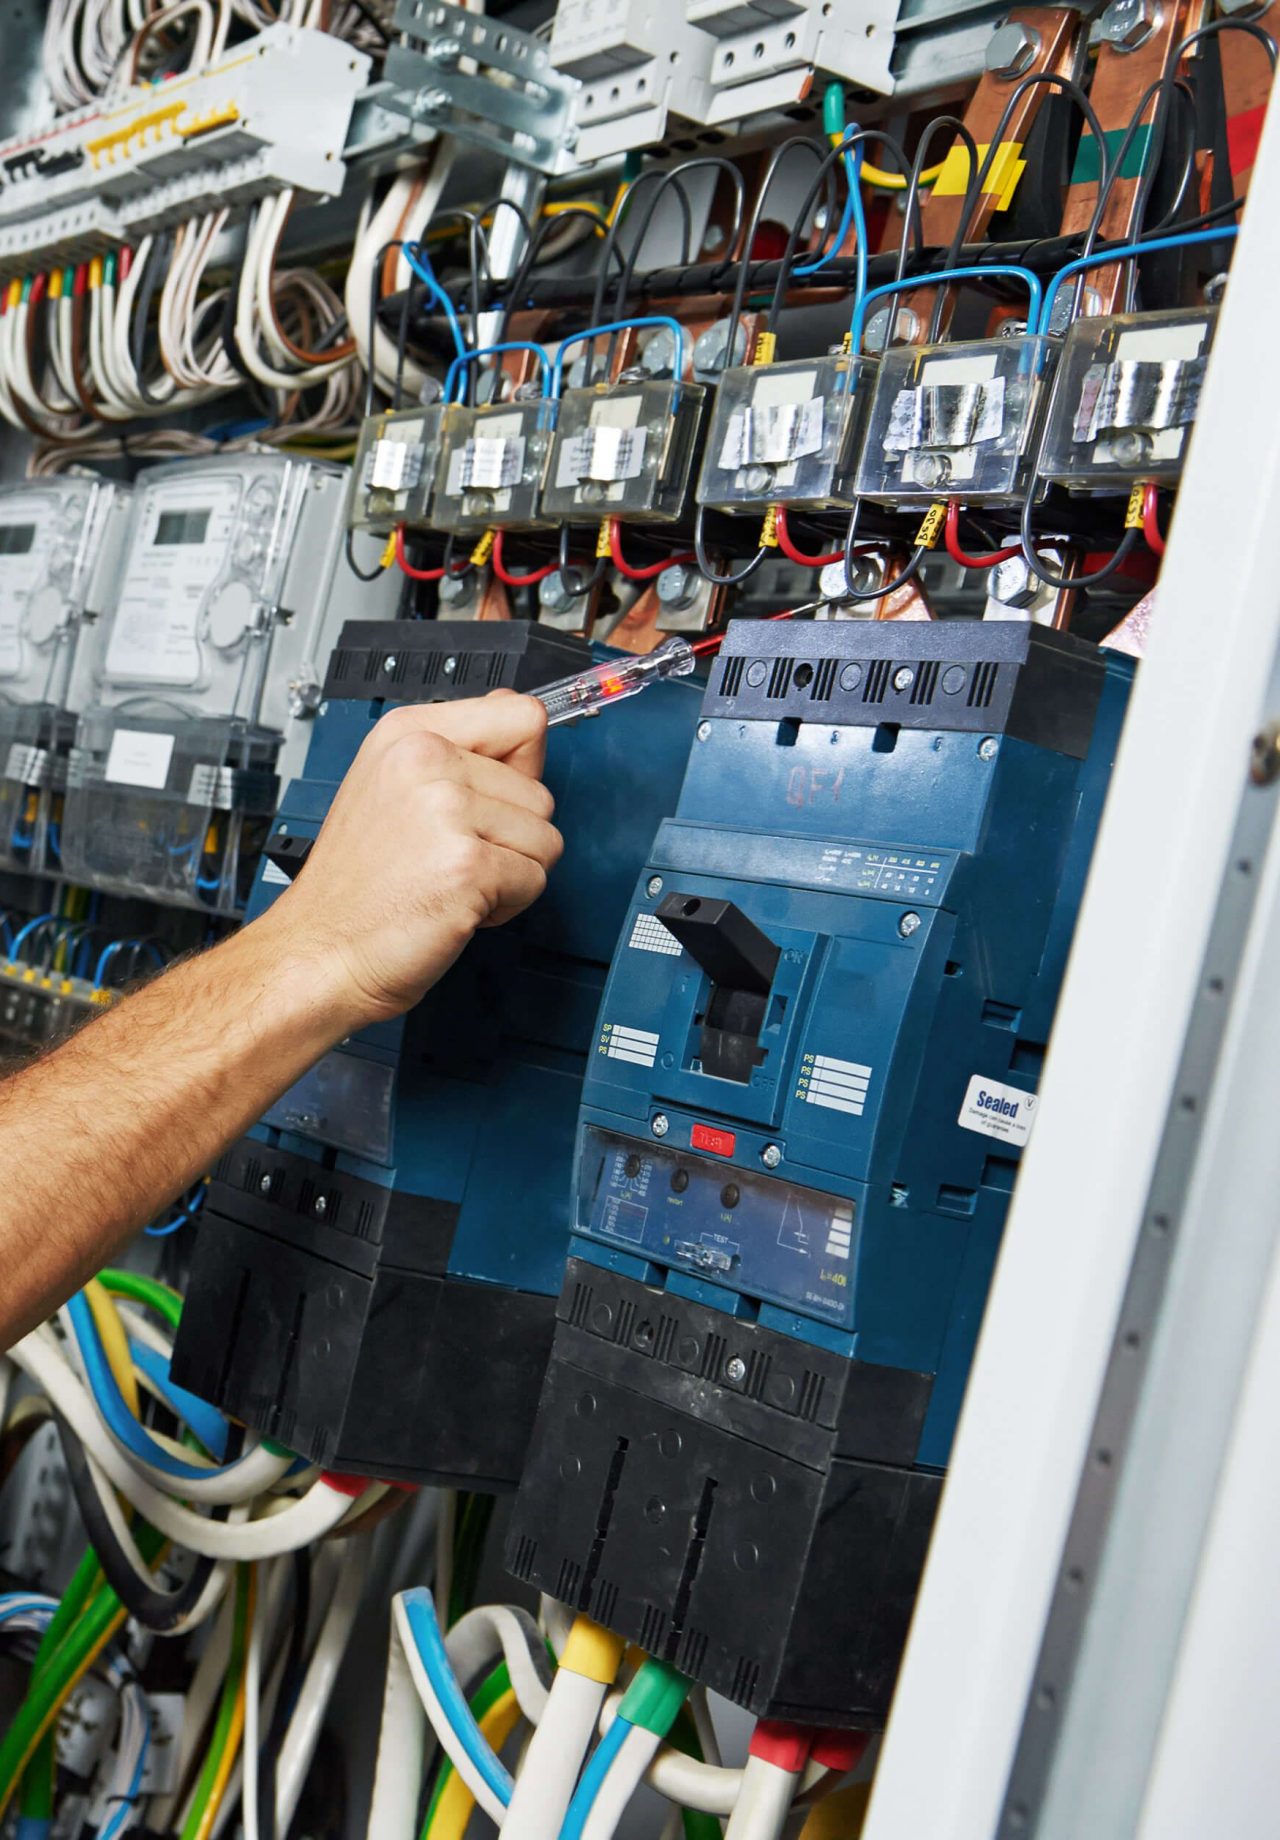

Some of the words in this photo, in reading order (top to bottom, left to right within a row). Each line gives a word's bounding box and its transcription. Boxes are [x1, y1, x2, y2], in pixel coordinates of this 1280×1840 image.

[803, 1053, 815, 1064] PS
[800, 1065, 812, 1076] PS
[797, 1077, 809, 1088] PS
[795, 1089, 807, 1100] PS
[977, 1090, 1019, 1118] Sealed
[713, 1233, 729, 1244] TEST
